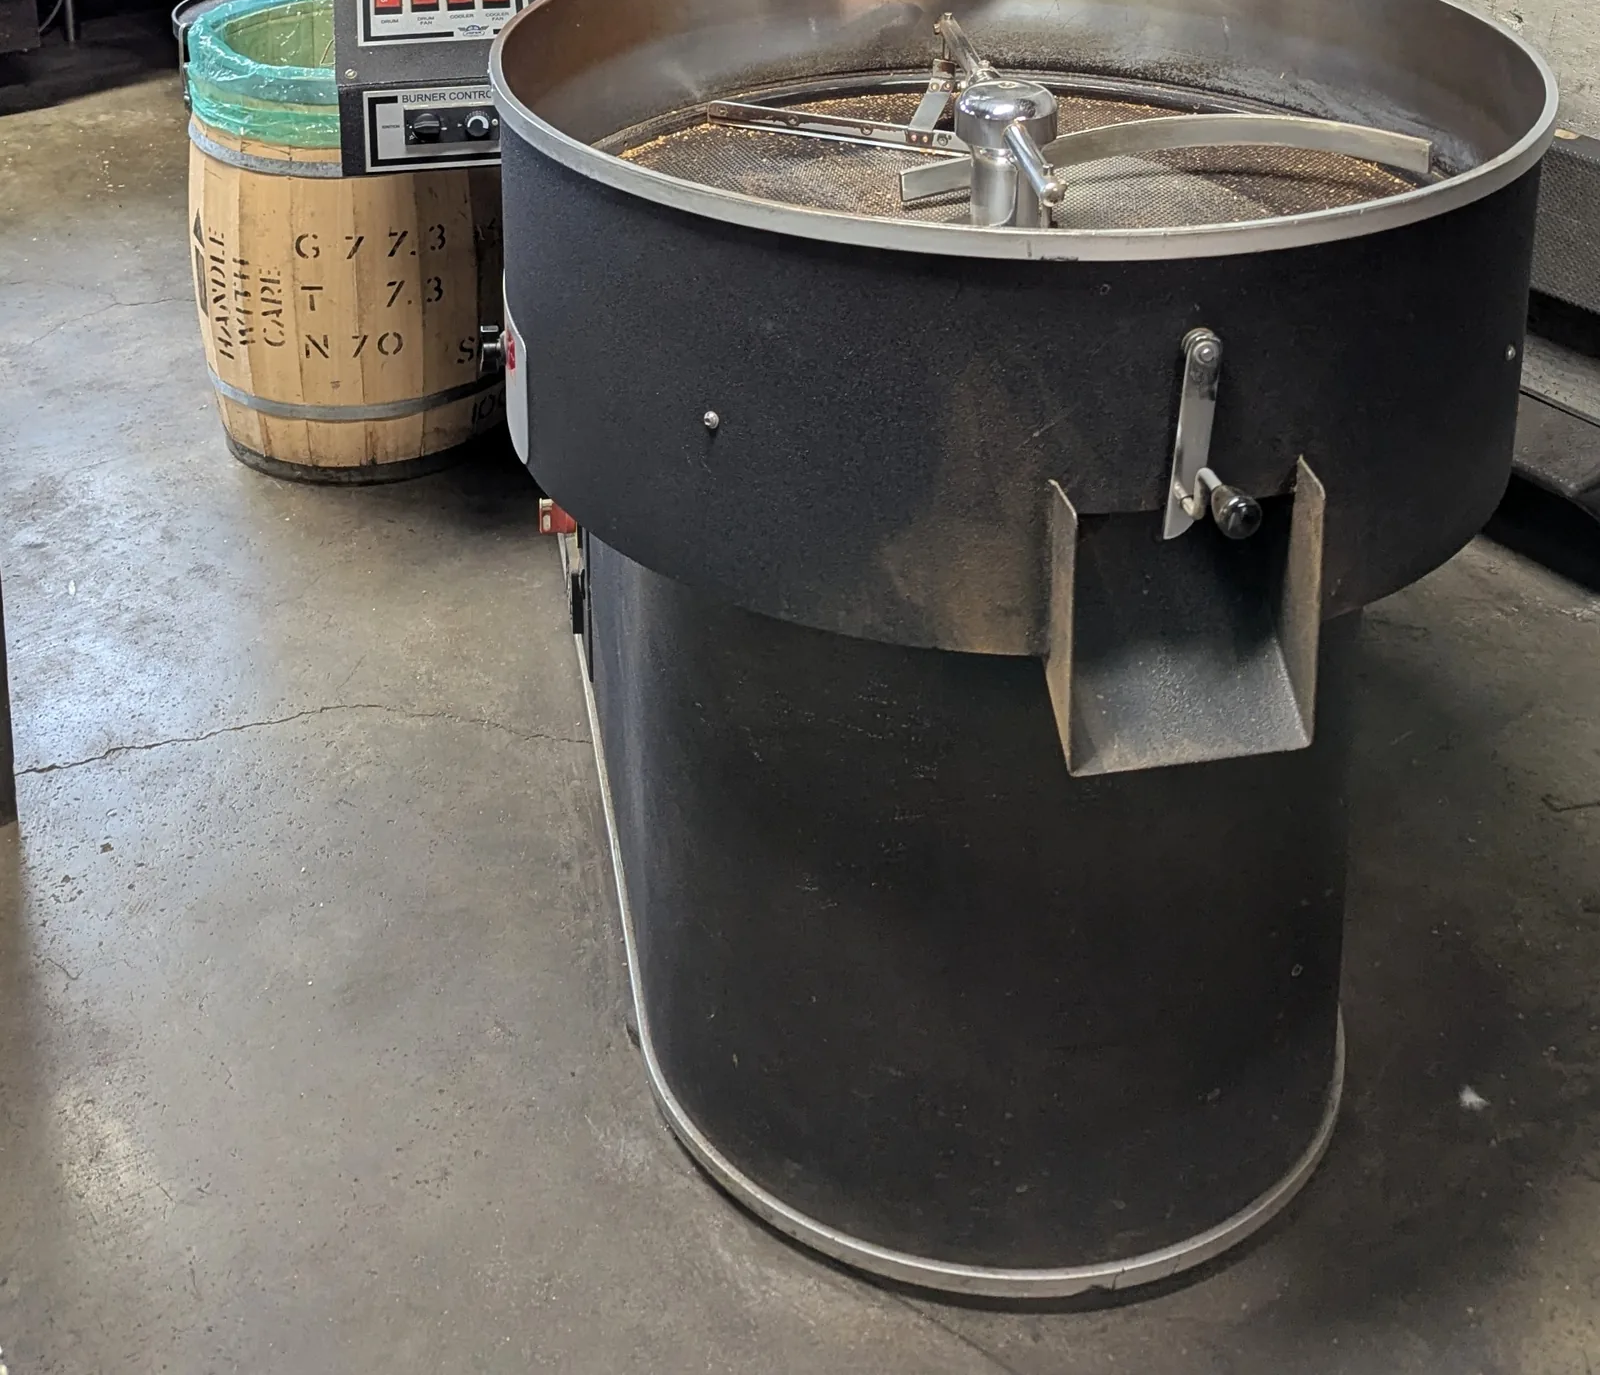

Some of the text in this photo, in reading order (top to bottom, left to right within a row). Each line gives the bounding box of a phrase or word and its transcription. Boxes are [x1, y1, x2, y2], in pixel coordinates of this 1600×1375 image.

[402, 93, 446, 104] BURNER
[295, 233, 320, 259] G
[208, 226, 235, 360] HANDLE
[300, 285, 324, 312] T
[259, 268, 286, 347] CARE
[304, 334, 330, 359] N
